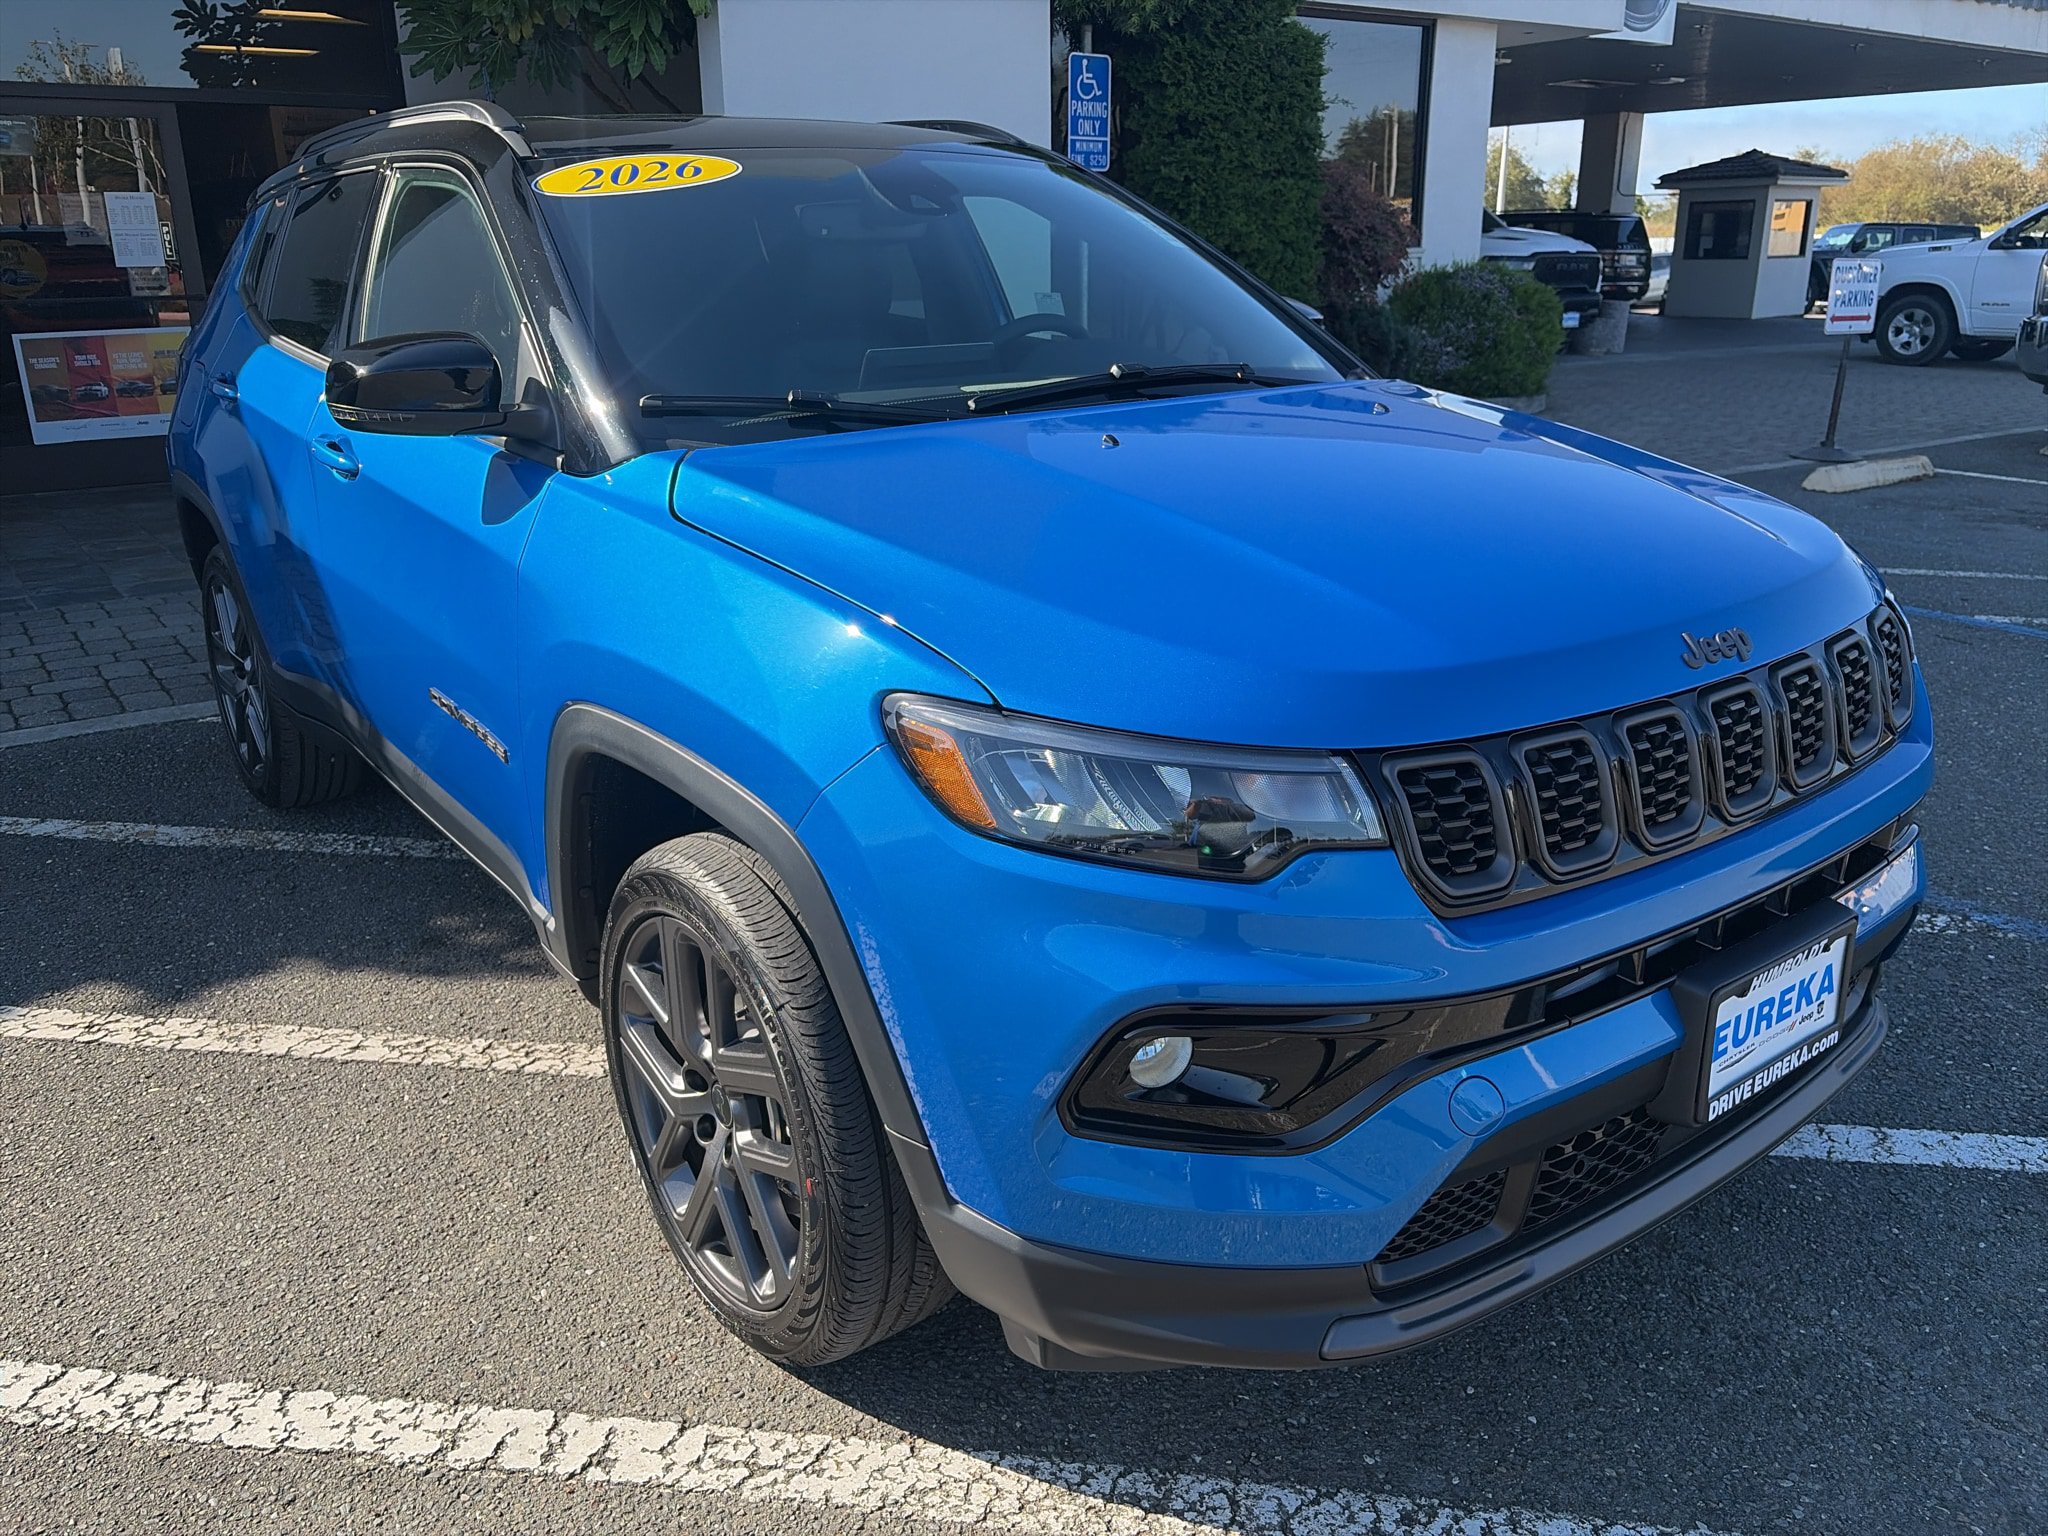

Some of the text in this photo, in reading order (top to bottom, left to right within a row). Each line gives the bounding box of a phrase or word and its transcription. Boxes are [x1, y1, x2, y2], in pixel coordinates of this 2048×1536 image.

[1072, 100, 1107, 118] PARKING
[1078, 119, 1101, 136] ONLY
[1075, 141, 1103, 153] MINIMUM
[576, 158, 704, 192] 2026
[162, 226, 173, 255] PULL
[1834, 265, 1879, 284] CUSTOMER
[1834, 289, 1875, 308] PARKING
[1681, 627, 1754, 670] Jeep
[1748, 938, 1829, 994] HUMBOLDT
[1712, 963, 1834, 1062] EUREKA
[1718, 1042, 1756, 1067] CHRYSLER
[1799, 1011, 1814, 1026] Jeep
